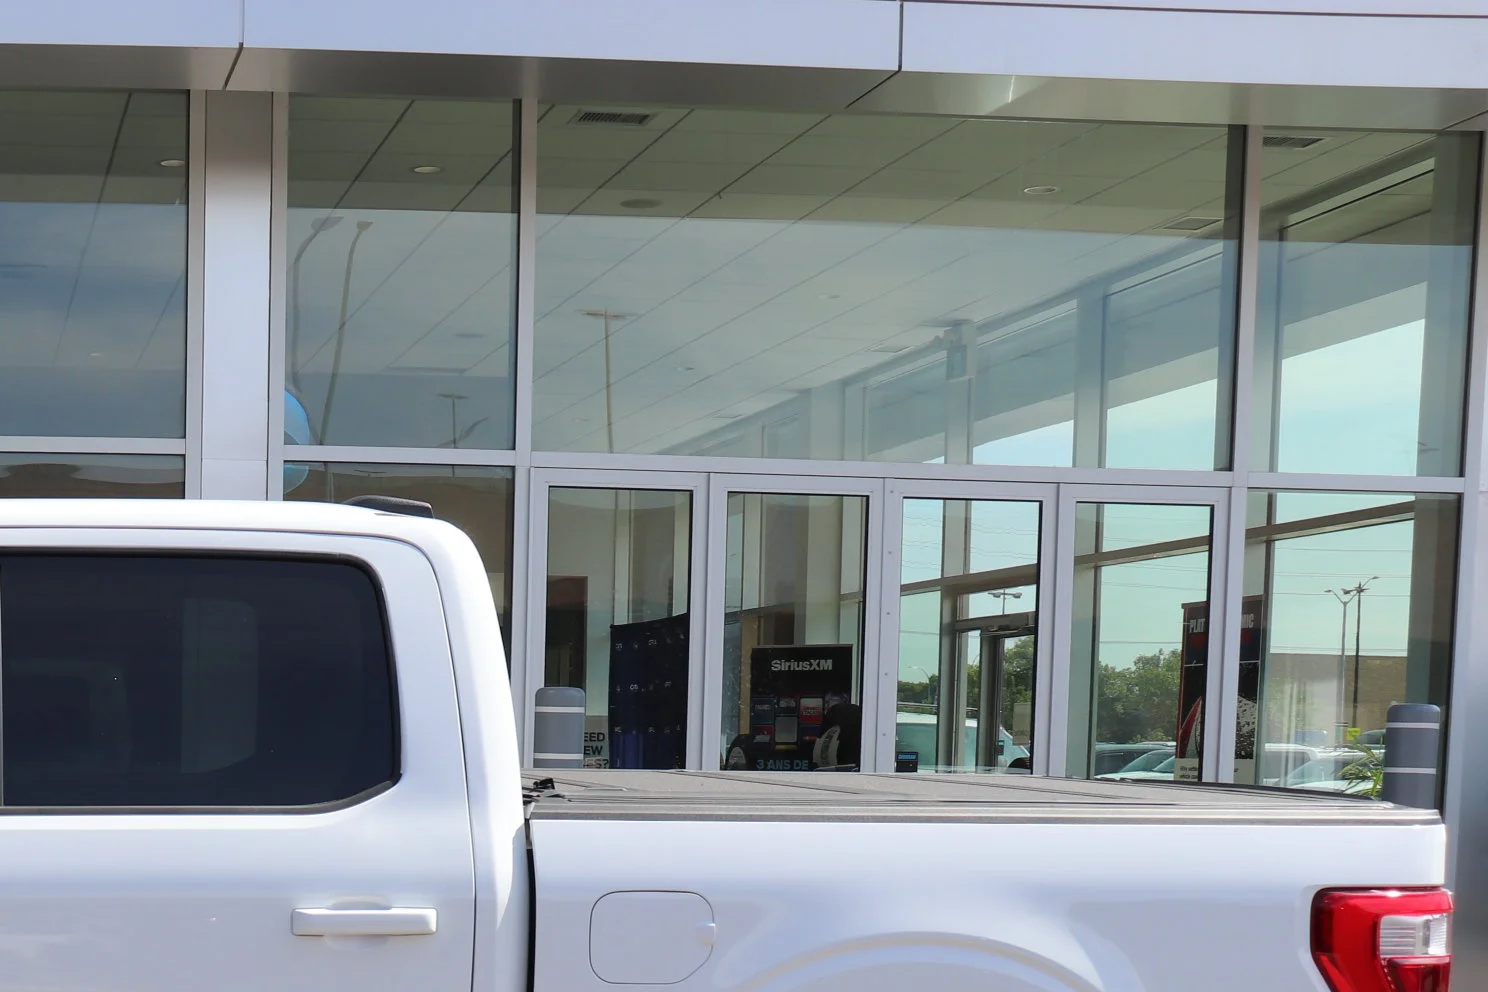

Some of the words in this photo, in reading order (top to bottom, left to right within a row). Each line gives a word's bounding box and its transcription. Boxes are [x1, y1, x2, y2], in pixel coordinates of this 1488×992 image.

[771, 659, 833, 671] SiriusXM
[584, 745, 603, 755] EW
[756, 759, 764, 770] 3
[766, 759, 791, 770] ANS
[793, 759, 809, 769] DE
